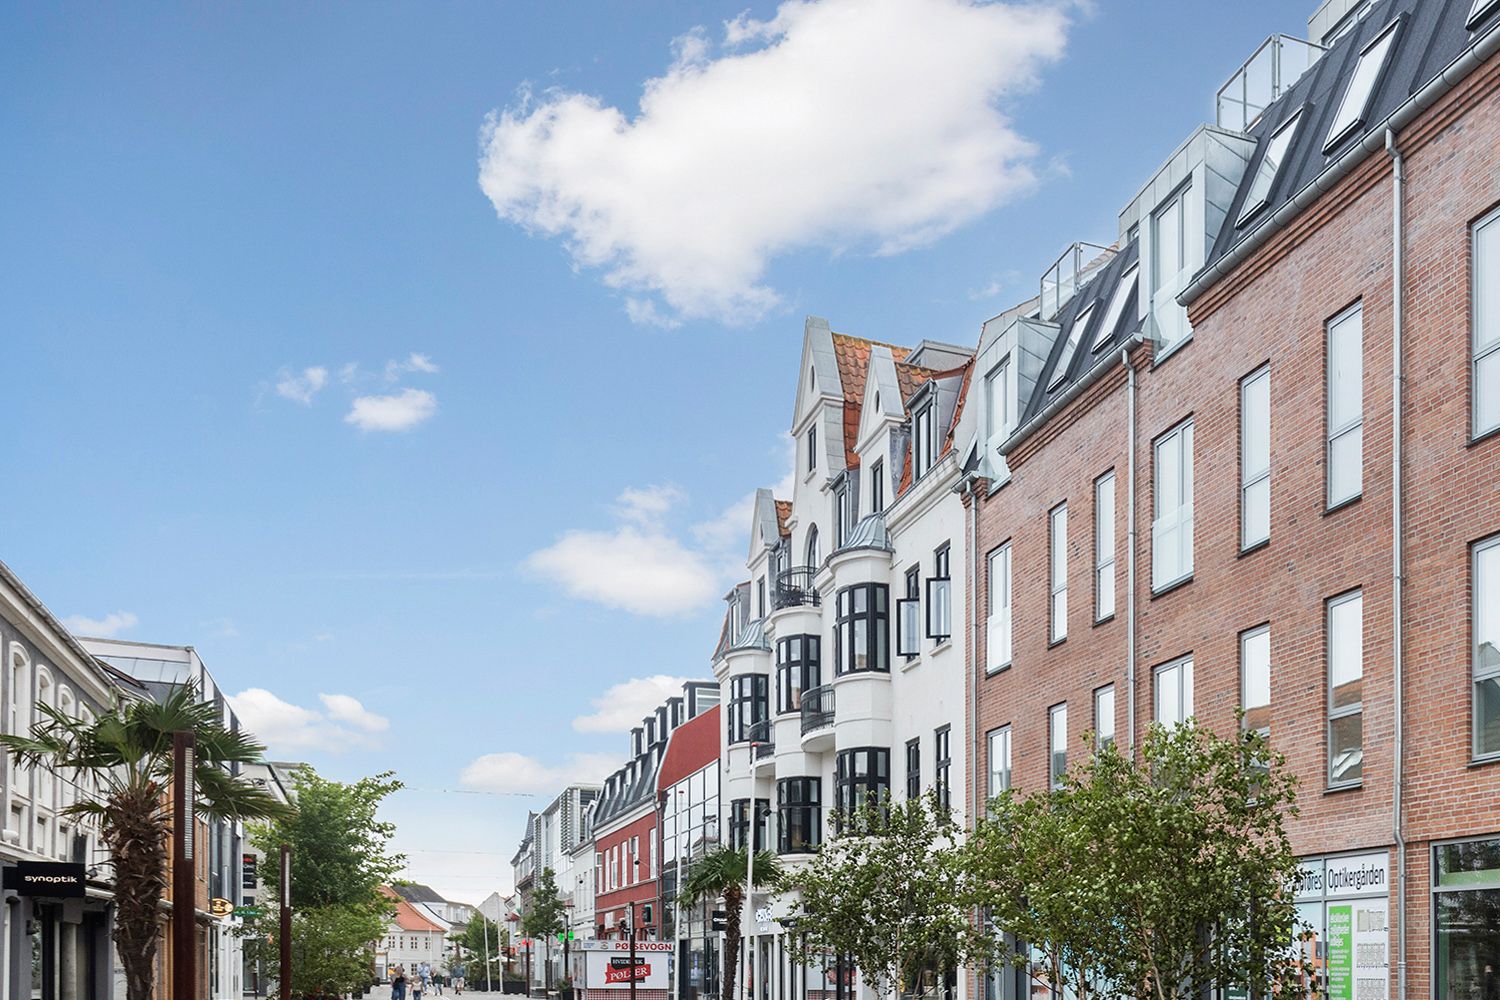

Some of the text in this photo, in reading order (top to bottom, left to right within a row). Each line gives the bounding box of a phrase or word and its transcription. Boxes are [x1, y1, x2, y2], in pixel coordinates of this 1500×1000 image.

[24, 875, 78, 884] synoptik
[1328, 863, 1385, 892] Optikergården
[615, 942, 673, 951] PØSEVOGN
[610, 966, 648, 981] PØLER
